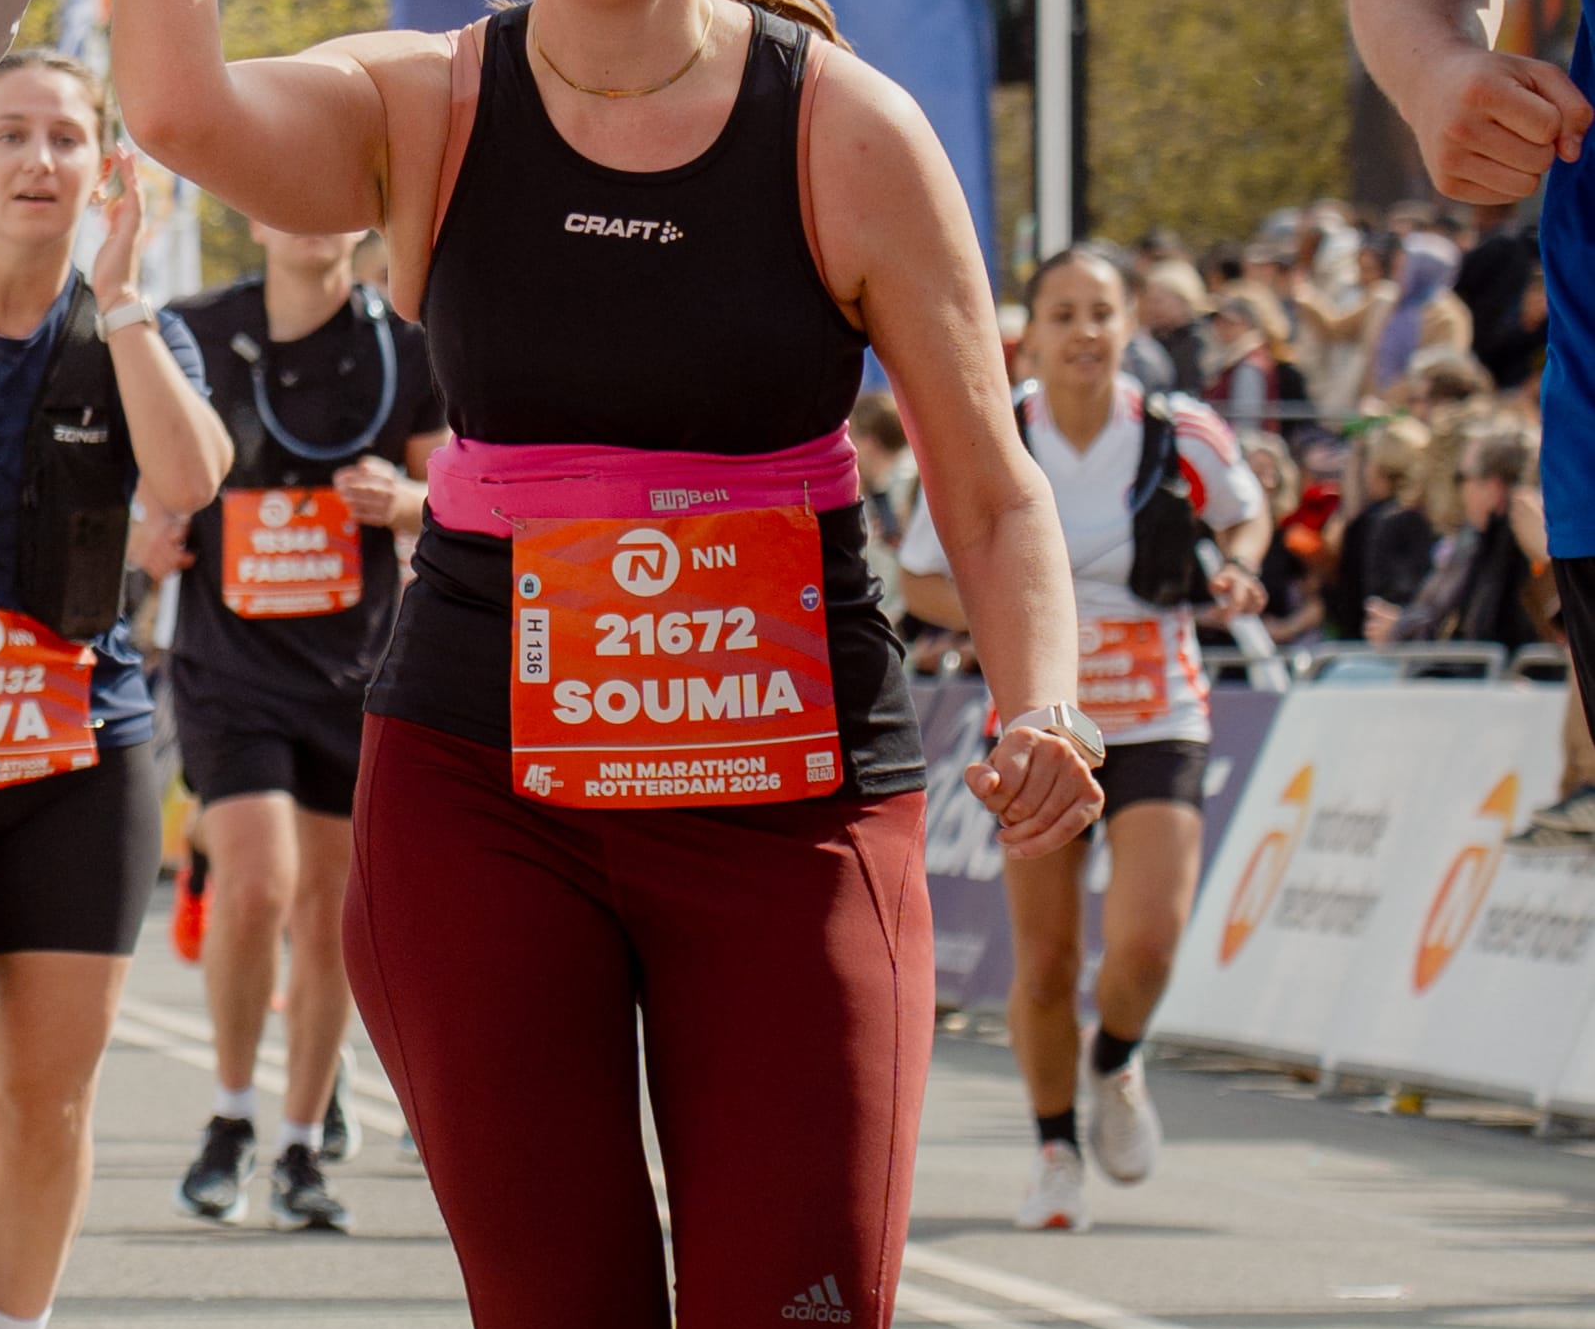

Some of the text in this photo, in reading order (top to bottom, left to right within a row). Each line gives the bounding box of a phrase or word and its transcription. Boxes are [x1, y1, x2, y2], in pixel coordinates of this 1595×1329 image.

[564, 213, 660, 241] CRAFT
[650, 488, 731, 510] FlipBelt
[690, 545, 736, 569] NN
[595, 607, 758, 655] 21672
[525, 618, 544, 675] H 136
[553, 670, 804, 724] SOUMIA
[600, 757, 765, 778] NN MARATHON
[585, 777, 725, 796] ROTTERDAM
[730, 773, 781, 791] 2026
[781, 1301, 852, 1325] adidas
